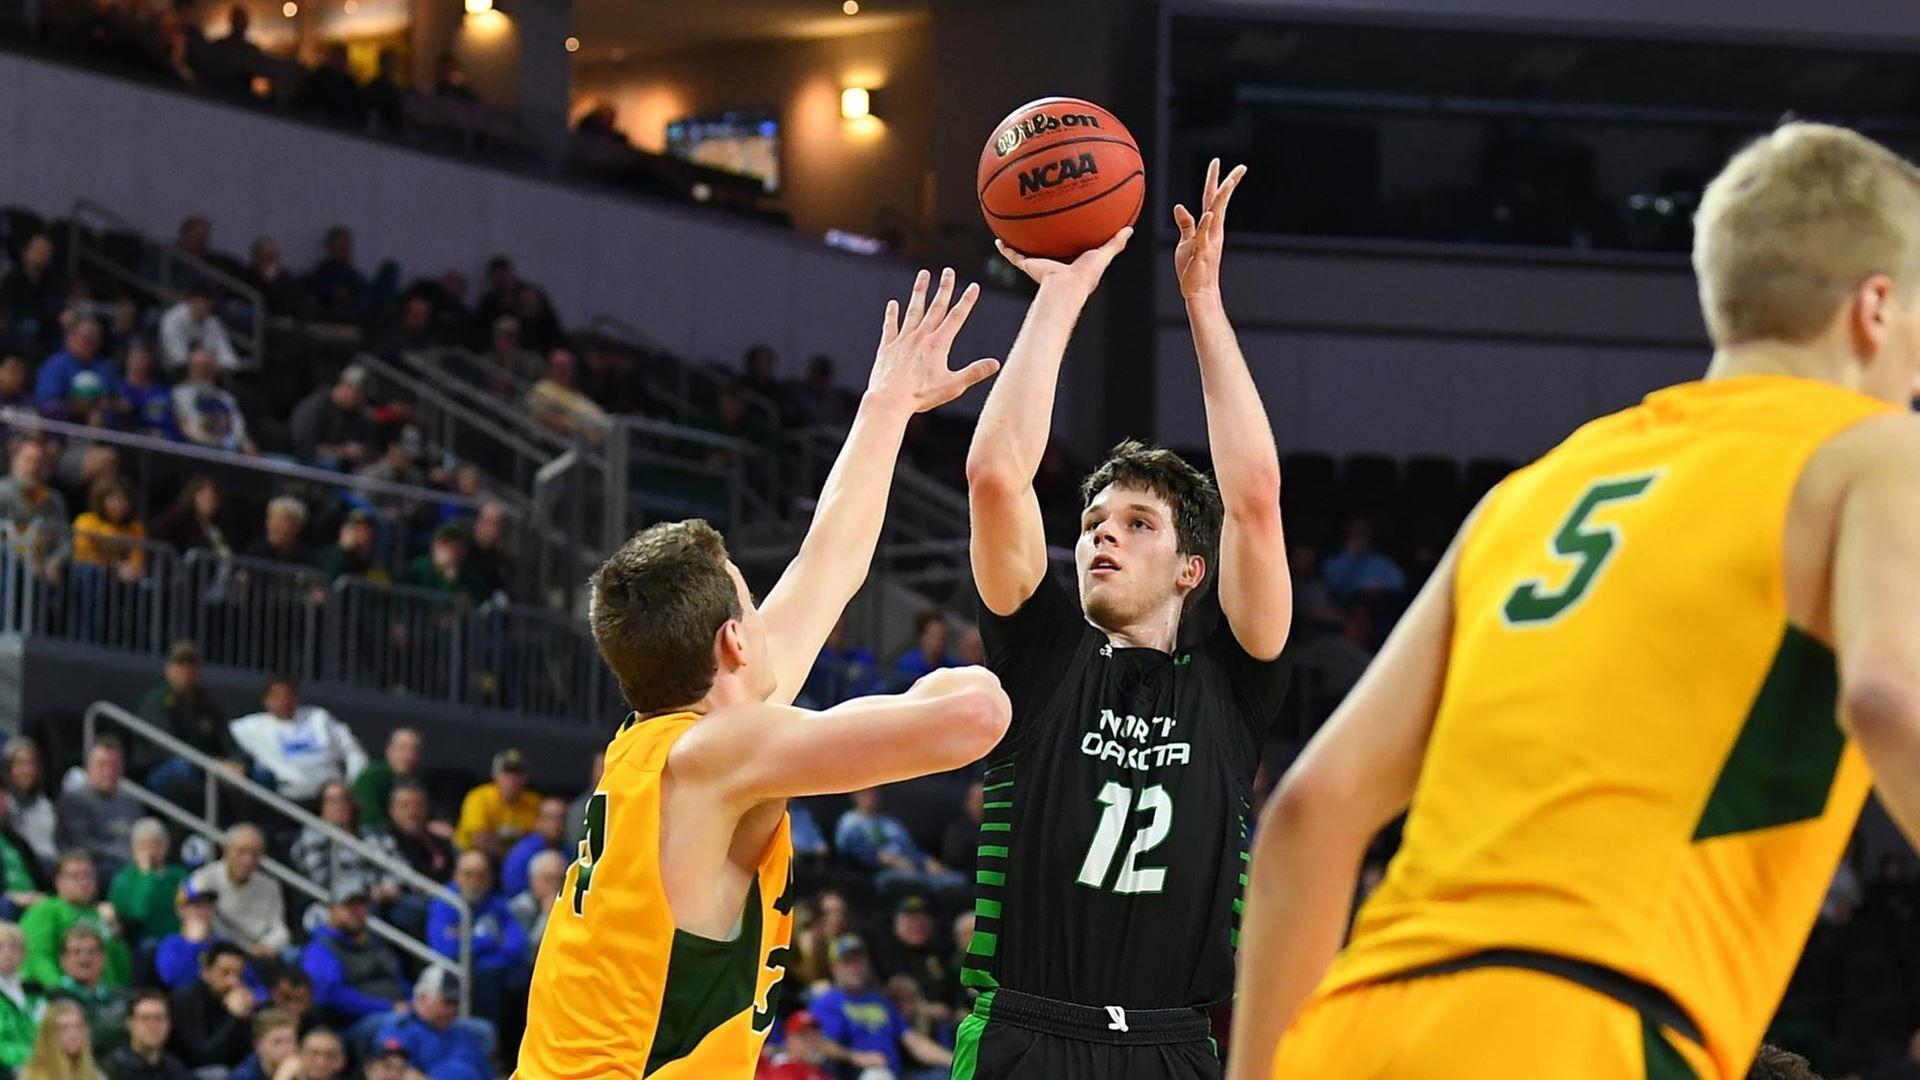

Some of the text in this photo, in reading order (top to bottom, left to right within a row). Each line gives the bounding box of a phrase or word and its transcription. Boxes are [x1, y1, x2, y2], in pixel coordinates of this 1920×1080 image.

[995, 113, 1100, 157] Wilson
[1018, 153, 1098, 197] NCAA
[1503, 470, 1664, 625] 5
[1076, 780, 1174, 895] 12
